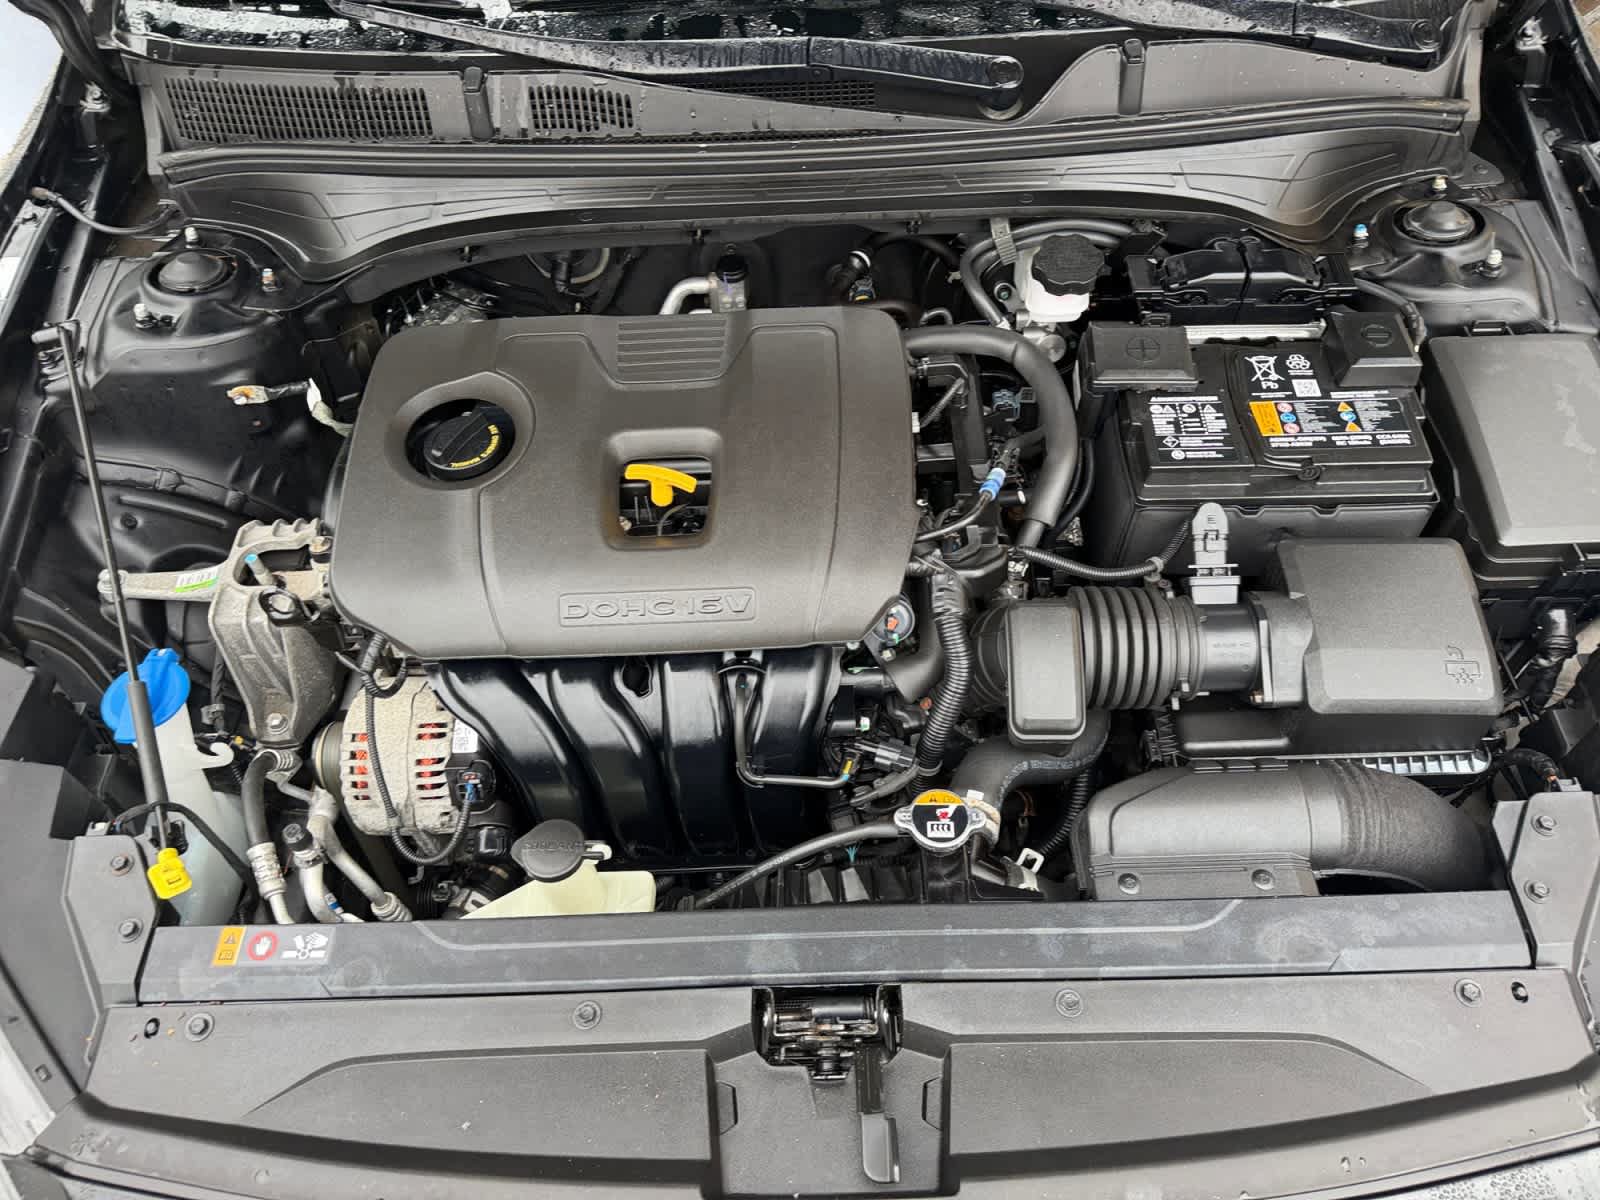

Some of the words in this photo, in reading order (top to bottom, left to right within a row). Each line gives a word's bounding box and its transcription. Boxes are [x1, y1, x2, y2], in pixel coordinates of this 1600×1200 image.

[1261, 380, 1279, 390] Pb
[562, 598, 675, 619] DOHC
[685, 593, 753, 616] 16V
